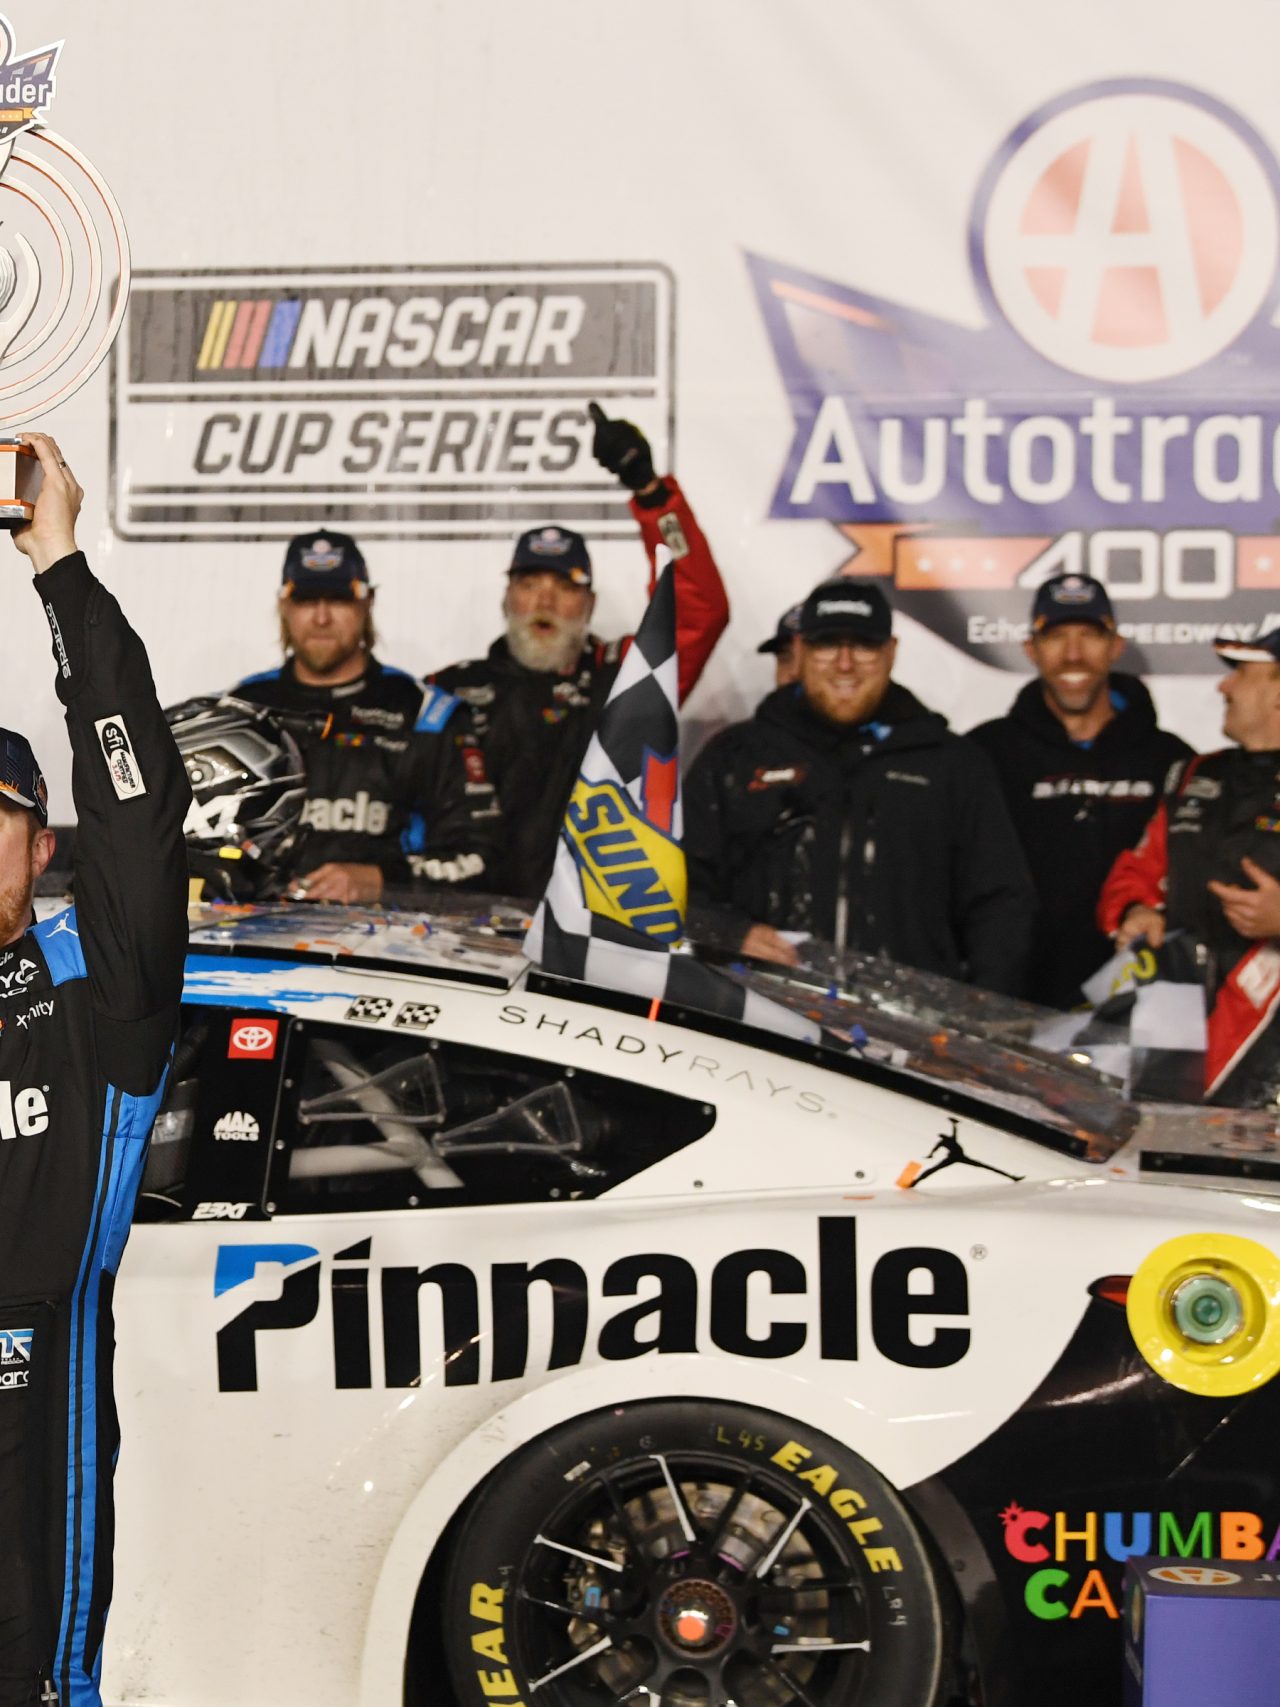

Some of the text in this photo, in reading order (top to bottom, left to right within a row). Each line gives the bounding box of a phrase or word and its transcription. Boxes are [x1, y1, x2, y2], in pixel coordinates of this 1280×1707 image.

[289, 295, 586, 369] NASCAR
[192, 408, 589, 475] CUP SERIES
[788, 395, 1280, 504] Autotra
[1017, 529, 1234, 601] 400
[1118, 620, 1256, 646] PEEDWAY
[106, 728, 124, 749] sfi
[214, 1110, 260, 1132] MAC
[214, 1131, 259, 1141] TOOLS
[213, 1216, 971, 1392] Pinnacle
[769, 1440, 903, 1573] EAGLE
[1024, 1568, 1124, 1620] CA
